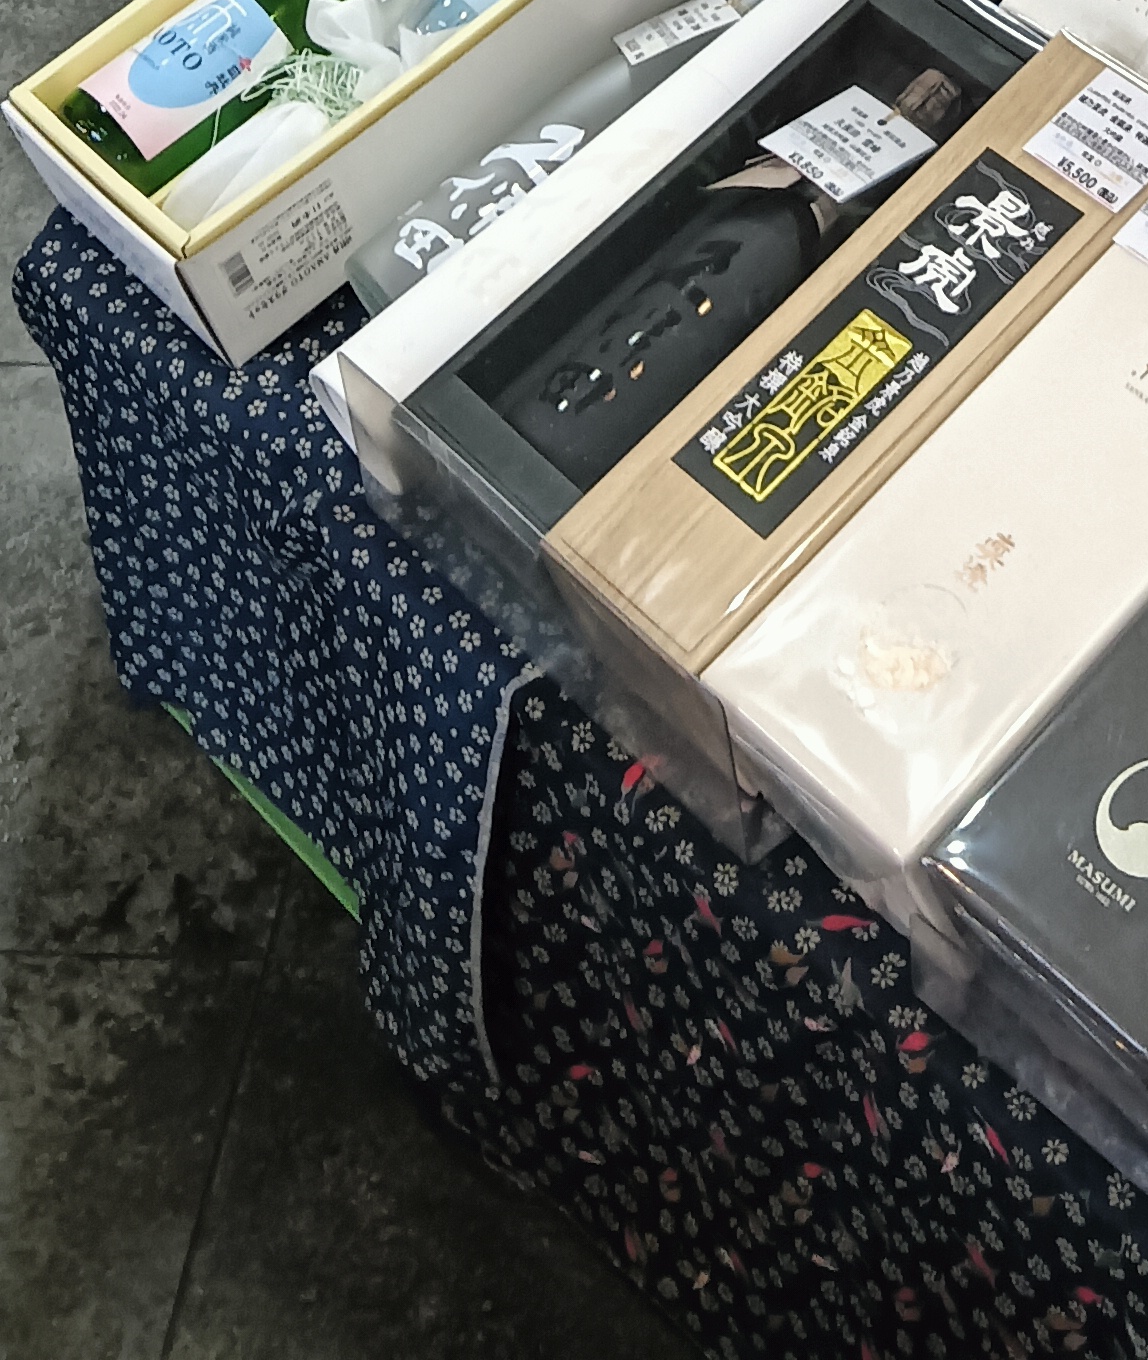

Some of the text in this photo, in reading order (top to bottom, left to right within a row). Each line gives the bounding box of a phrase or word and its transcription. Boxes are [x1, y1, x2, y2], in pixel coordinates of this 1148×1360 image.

[1057, 156, 1098, 190] ¥5,500
[899, 191, 1031, 316] 景虎
[1067, 849, 1137, 914] MASUMI
